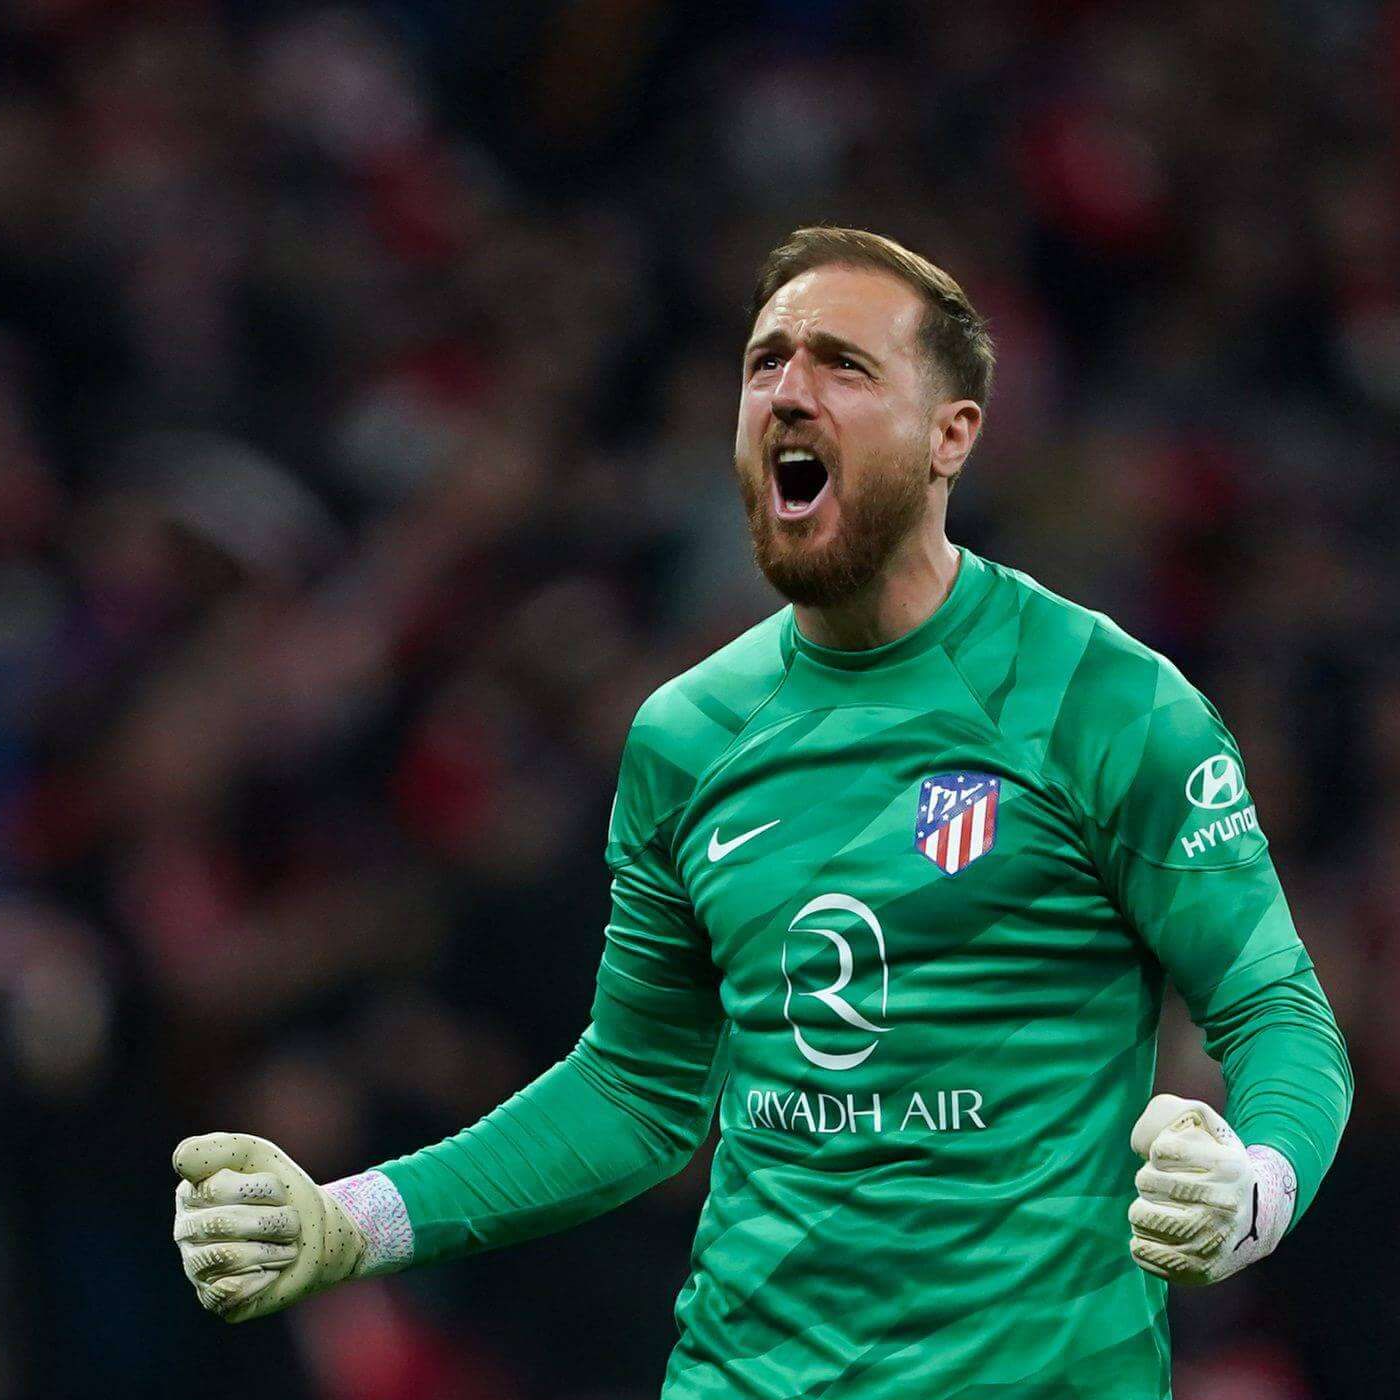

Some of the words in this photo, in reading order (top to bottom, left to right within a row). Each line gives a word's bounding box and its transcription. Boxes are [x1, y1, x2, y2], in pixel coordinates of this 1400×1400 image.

[1181, 804, 1258, 858] HYUND
[747, 1090, 882, 1134] RIYADH
[900, 1089, 986, 1131] AIR
